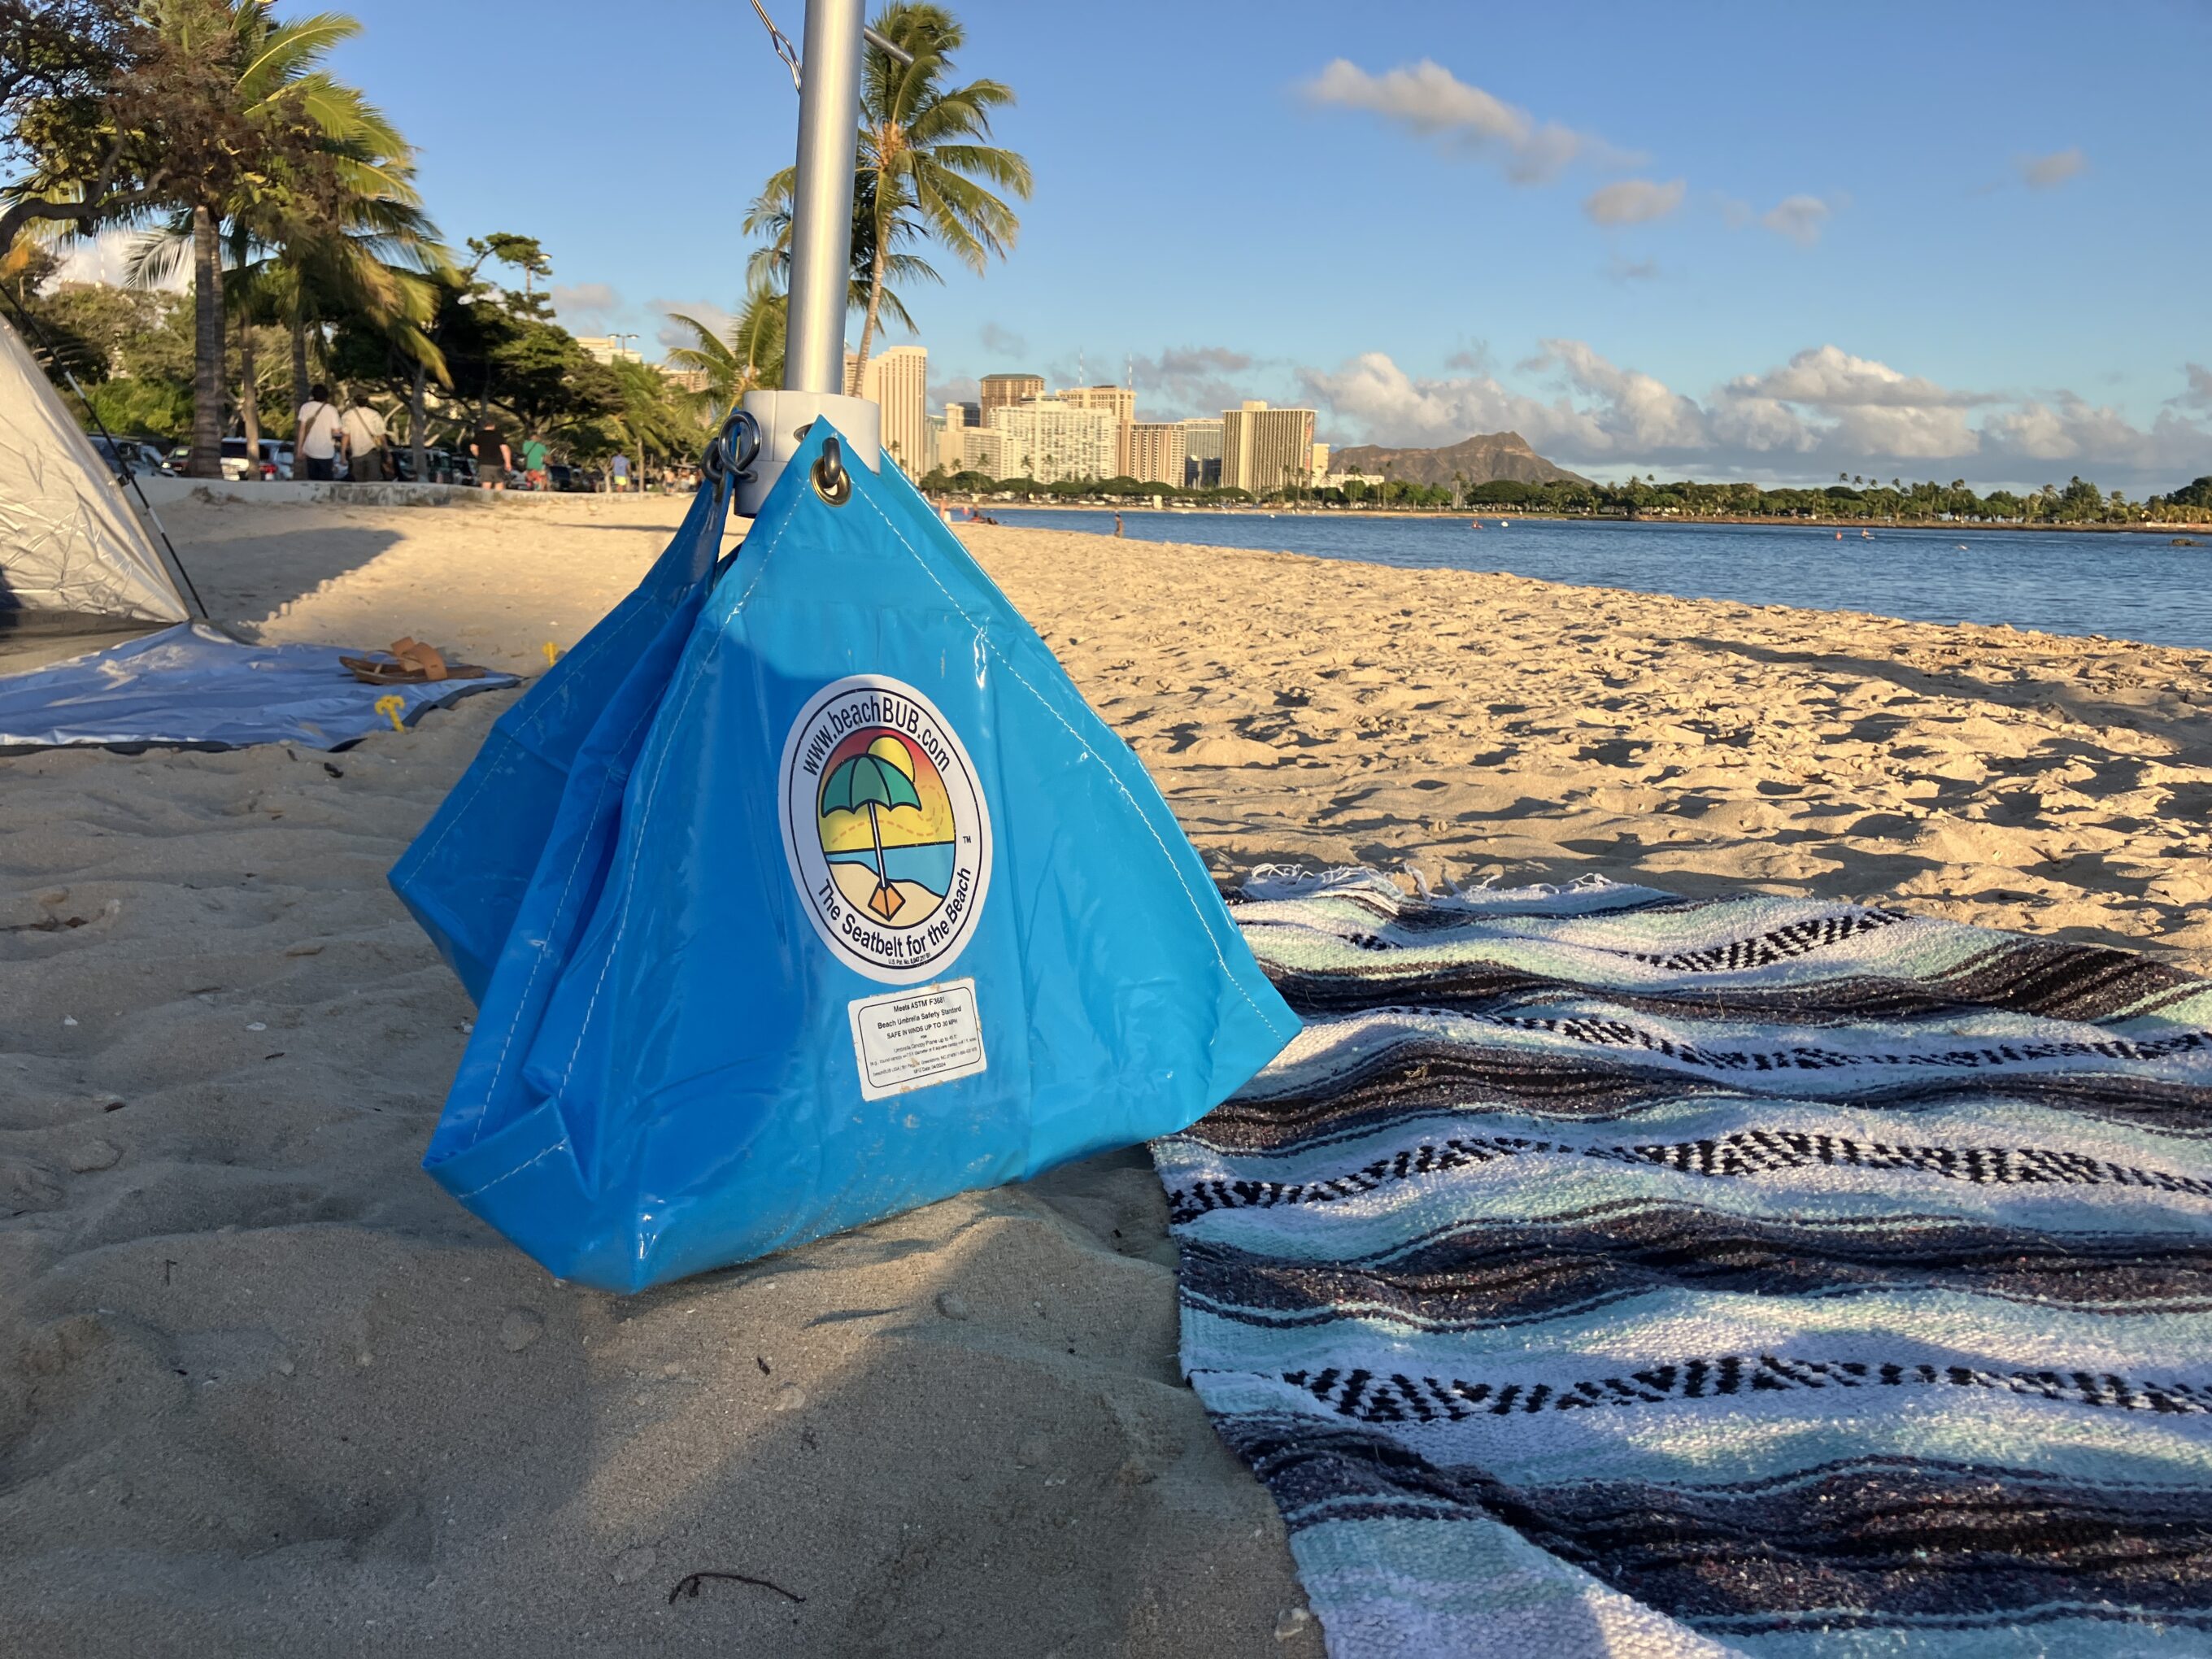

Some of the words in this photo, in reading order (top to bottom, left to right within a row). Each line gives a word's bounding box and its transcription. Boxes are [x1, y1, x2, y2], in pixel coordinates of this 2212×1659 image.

[803, 695, 950, 776] www.beachBUB.com
[819, 878, 841, 921] The
[842, 913, 904, 958] Seatbelt
[906, 934, 928, 956] for
[928, 920, 950, 947] the
[945, 868, 971, 925] Beach
[877, 1019, 896, 1030] Beach
[897, 1014, 921, 1025] Umbrella
[921, 1010, 940, 1020] Safety
[941, 1005, 962, 1016] Standard
[893, 1004, 910, 1012] Meets
[886, 1030, 902, 1039] SAFE
[908, 1025, 924, 1034] WINDS
